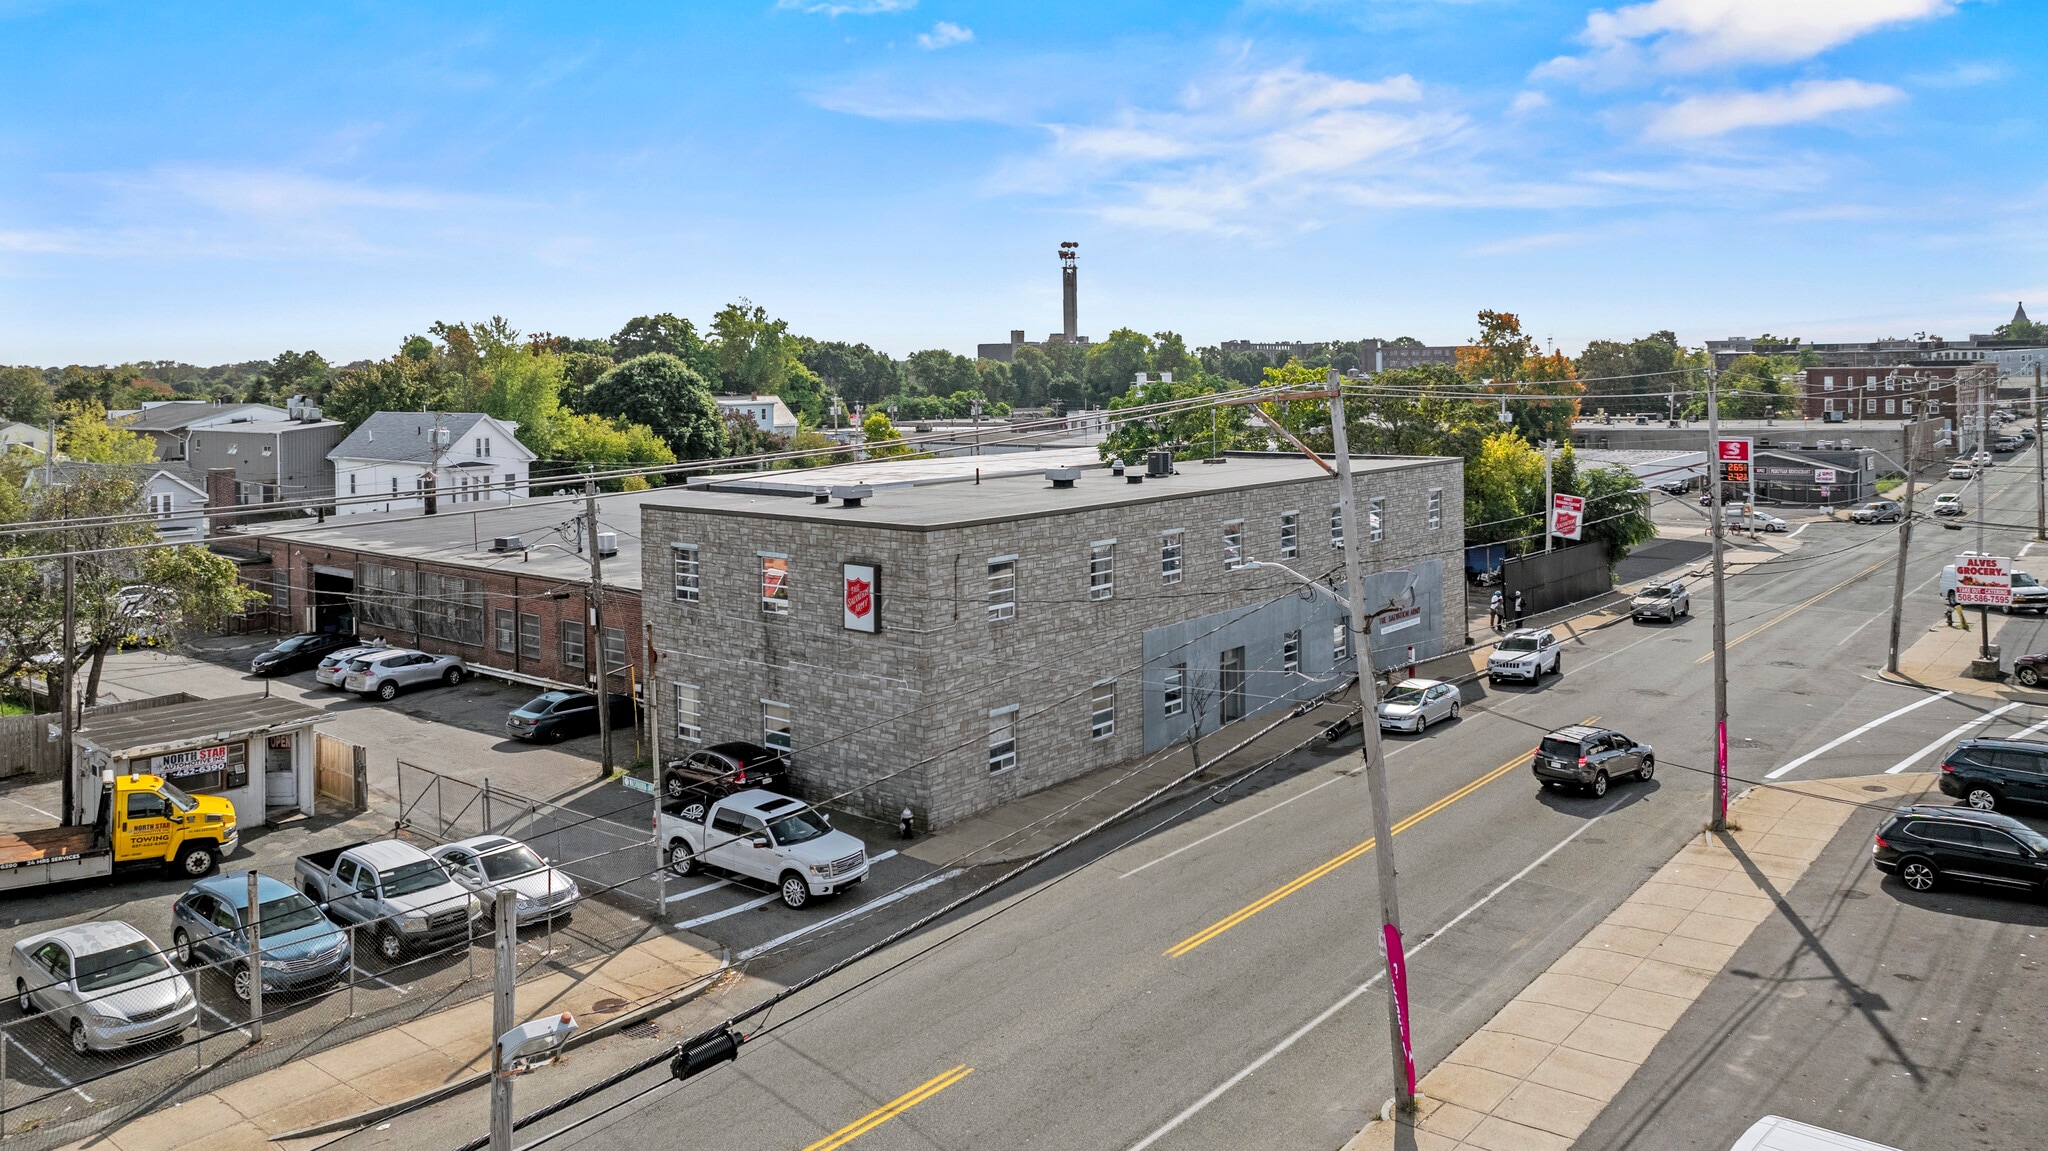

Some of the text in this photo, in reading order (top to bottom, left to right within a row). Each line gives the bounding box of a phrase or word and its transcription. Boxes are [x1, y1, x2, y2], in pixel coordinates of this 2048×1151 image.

[1967, 559, 1997, 567] ALVES
[1957, 567, 2002, 576] GROCERY
[847, 587, 869, 607] SALVATION
[1958, 594, 2009, 604] 508-586-7595
[855, 597, 869, 613] ARMY
[271, 735, 291, 748] OPEN
[163, 747, 225, 765] NORTH STAR
[164, 758, 210, 770] AUTOMOTIVE
[134, 823, 154, 831] NORTH
[131, 834, 170, 844] TOWING
[51, 853, 81, 862] SERVICES
